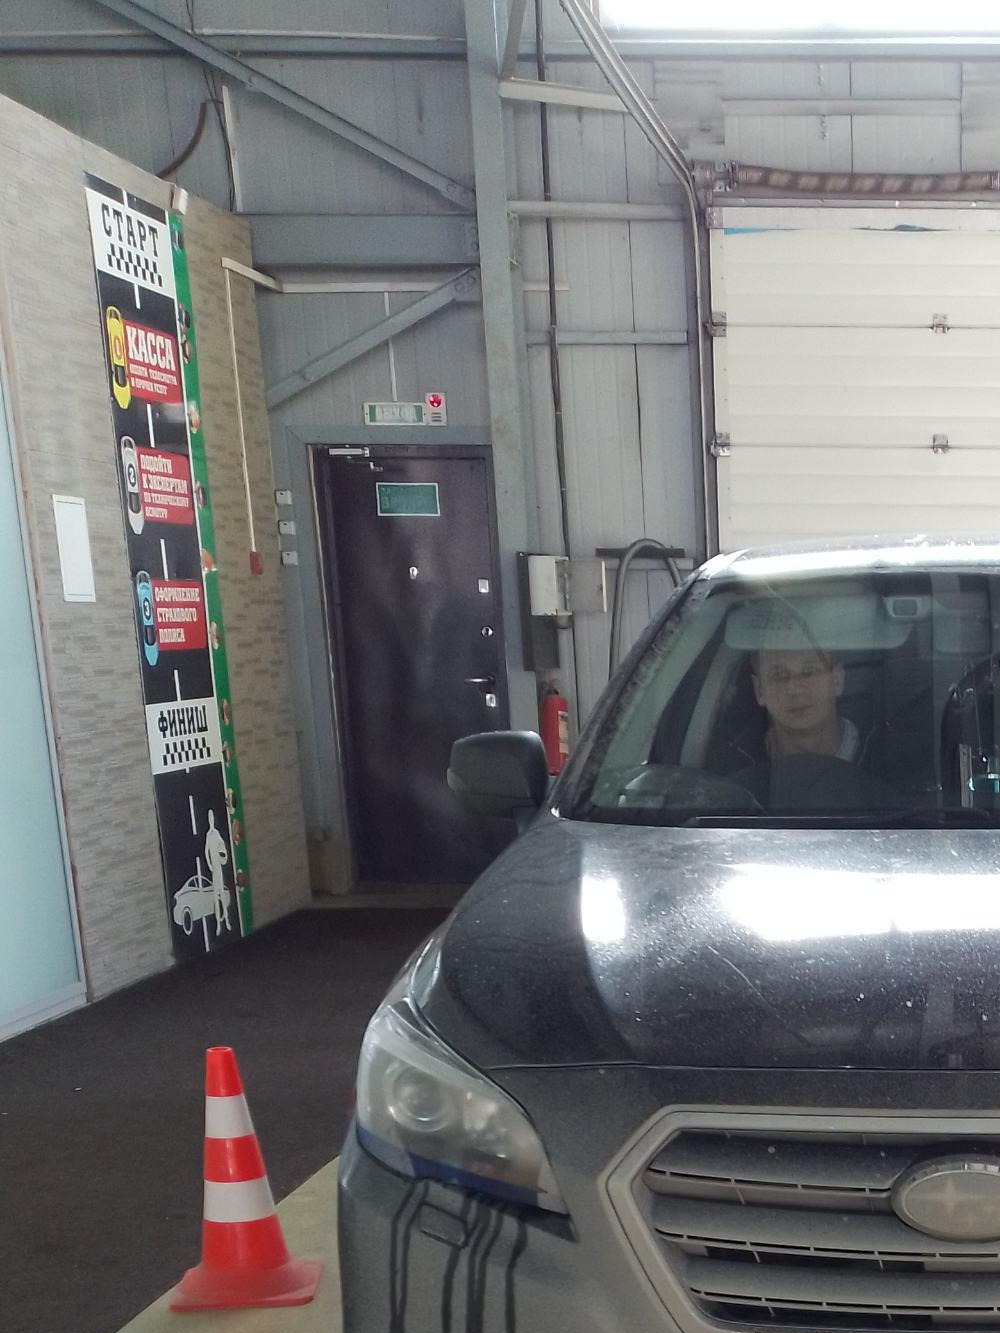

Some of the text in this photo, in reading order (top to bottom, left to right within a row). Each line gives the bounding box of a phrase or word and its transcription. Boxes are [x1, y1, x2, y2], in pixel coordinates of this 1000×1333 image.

[101, 203, 158, 257] СТАРТ
[126, 325, 176, 371] КАССА
[128, 467, 135, 483] 2
[142, 473, 148, 489] К
[154, 587, 200, 602] ОФОРМЛЕНИЕ
[144, 600, 150, 617] 3
[157, 608, 197, 622] СТРАХОВОГО
[158, 705, 208, 738] ФИНИШ
